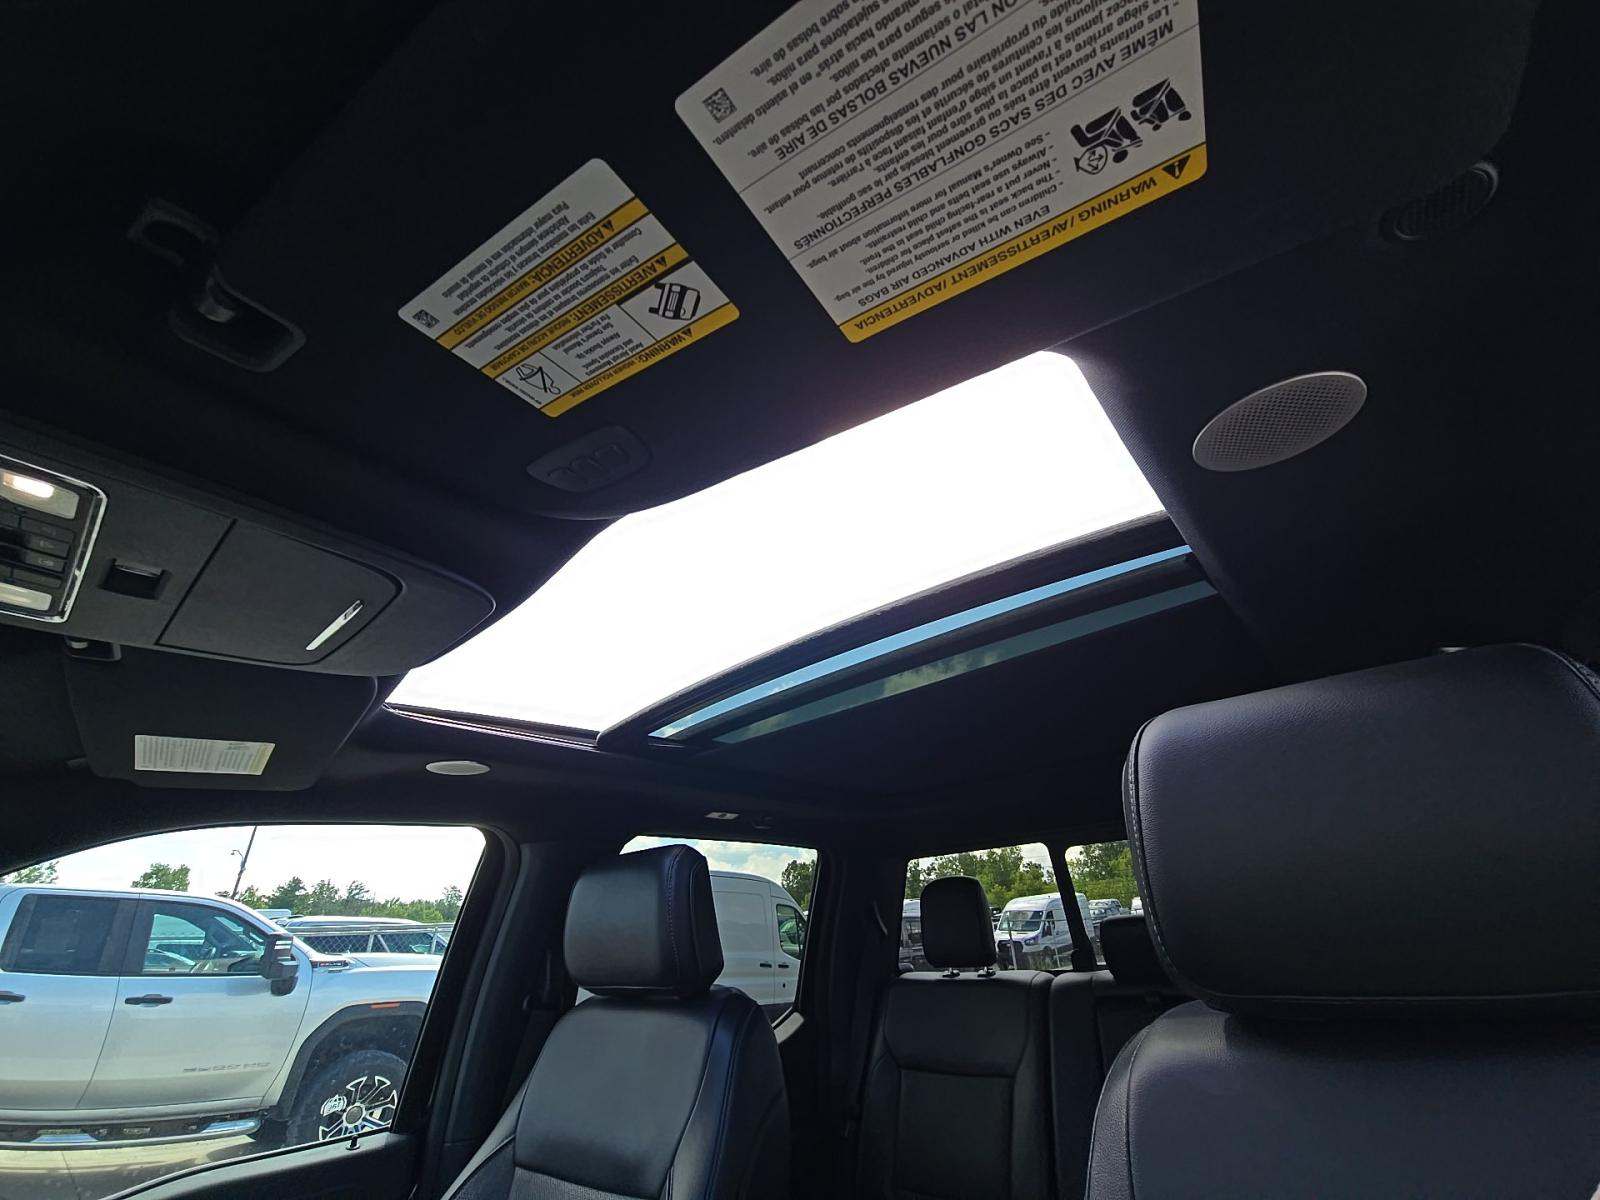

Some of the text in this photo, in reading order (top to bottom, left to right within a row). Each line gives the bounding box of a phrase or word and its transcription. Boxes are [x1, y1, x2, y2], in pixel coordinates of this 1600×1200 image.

[901, 0, 942, 33] seguro
[1031, 13, 1048, 33] du
[1146, 3, 1169, 27] Les
[817, 0, 881, 51] sujetadores
[953, 8, 988, 43] LAS
[1044, 20, 1063, 41] les
[1062, 8, 1105, 46] jamais
[785, 21, 821, 54] bolsas
[843, 25, 875, 55] hacia
[875, 25, 902, 51] para
[890, 14, 952, 64] seriamente
[1098, 18, 1144, 55] enfants
[771, 46, 788, 64] de
[794, 41, 820, 66] para
[859, 45, 878, 65] los
[886, 33, 952, 87] NUEVAS
[990, 33, 1043, 75] ceintures
[1053, 47, 1072, 67] est
[1040, 59, 1052, 75] la
[1050, 45, 1097, 83] peuvent
[797, 70, 813, 86] en
[840, 56, 892, 98] afectados
[938, 65, 964, 89] pour
[974, 67, 990, 84] de
[997, 69, 1012, 84] un
[1008, 65, 1039, 94] place
[918, 83, 940, 104] des
[996, 87, 1008, 101] la
[1026, 75, 1050, 97] être
[822, 87, 842, 107] por
[826, 77, 888, 126] BOLSAS
[971, 93, 995, 116] plus
[808, 101, 826, 119] las
[903, 111, 920, 128] les
[919, 104, 932, 118] et
[948, 109, 972, 130] sûre
[986, 105, 1001, 119] ou
[778, 112, 811, 139] bolsas
[805, 118, 828, 140] DE
[844, 94, 920, 150] renseignements
[924, 122, 948, 142] pour
[933, 112, 987, 152] gravement
[766, 132, 782, 147] de
[792, 18, 1173, 252] MÊME AVEC DES SACS GONFLABLES PERFECTIONNÉS
[854, 119, 905, 158] dispositifs
[891, 123, 926, 151] faisant
[1023, 133, 1044, 151] See
[773, 131, 809, 161] AIRE
[870, 144, 893, 163] face
[909, 138, 926, 154] les
[797, 144, 847, 180] concernant
[843, 151, 857, 166] de
[1010, 145, 1047, 172] Always
[810, 159, 845, 186] retenue
[881, 166, 898, 181] par
[991, 166, 1010, 181] use
[1022, 159, 1050, 180] Never
[1034, 171, 1053, 187] The
[790, 178, 811, 196] pour
[856, 183, 873, 196] sac
[872, 177, 883, 188] le
[947, 168, 982, 193] Manual
[970, 177, 991, 194] seat
[1002, 173, 1021, 190] put
[933, 187, 947, 200] for
[946, 189, 970, 207] belts
[1009, 182, 1034, 200] back
[1017, 183, 1057, 209] Children
[1077, 174, 1157, 223] WARNING
[909, 195, 932, 212] more
[928, 202, 947, 217] and
[978, 206, 988, 216] is
[988, 195, 1008, 211] seat
[999, 204, 1017, 217] can
[861, 208, 910, 239] information
[906, 211, 929, 228] child
[924, 215, 946, 232] child
[962, 211, 978, 224] the
[985, 213, 999, 225] be
[905, 227, 924, 242] seat
[935, 220, 962, 238] safest
[950, 233, 961, 242] or
[960, 220, 986, 238] killed
[838, 234, 863, 252] about
[880, 243, 896, 255] the
[898, 246, 912, 258] for
[911, 233, 935, 251] place
[912, 237, 951, 262] seriously
[856, 203, 1050, 308] EVEN WITH ADVANCED AIR BAGS
[873, 271, 886, 282] by
[884, 257, 914, 277] injured
